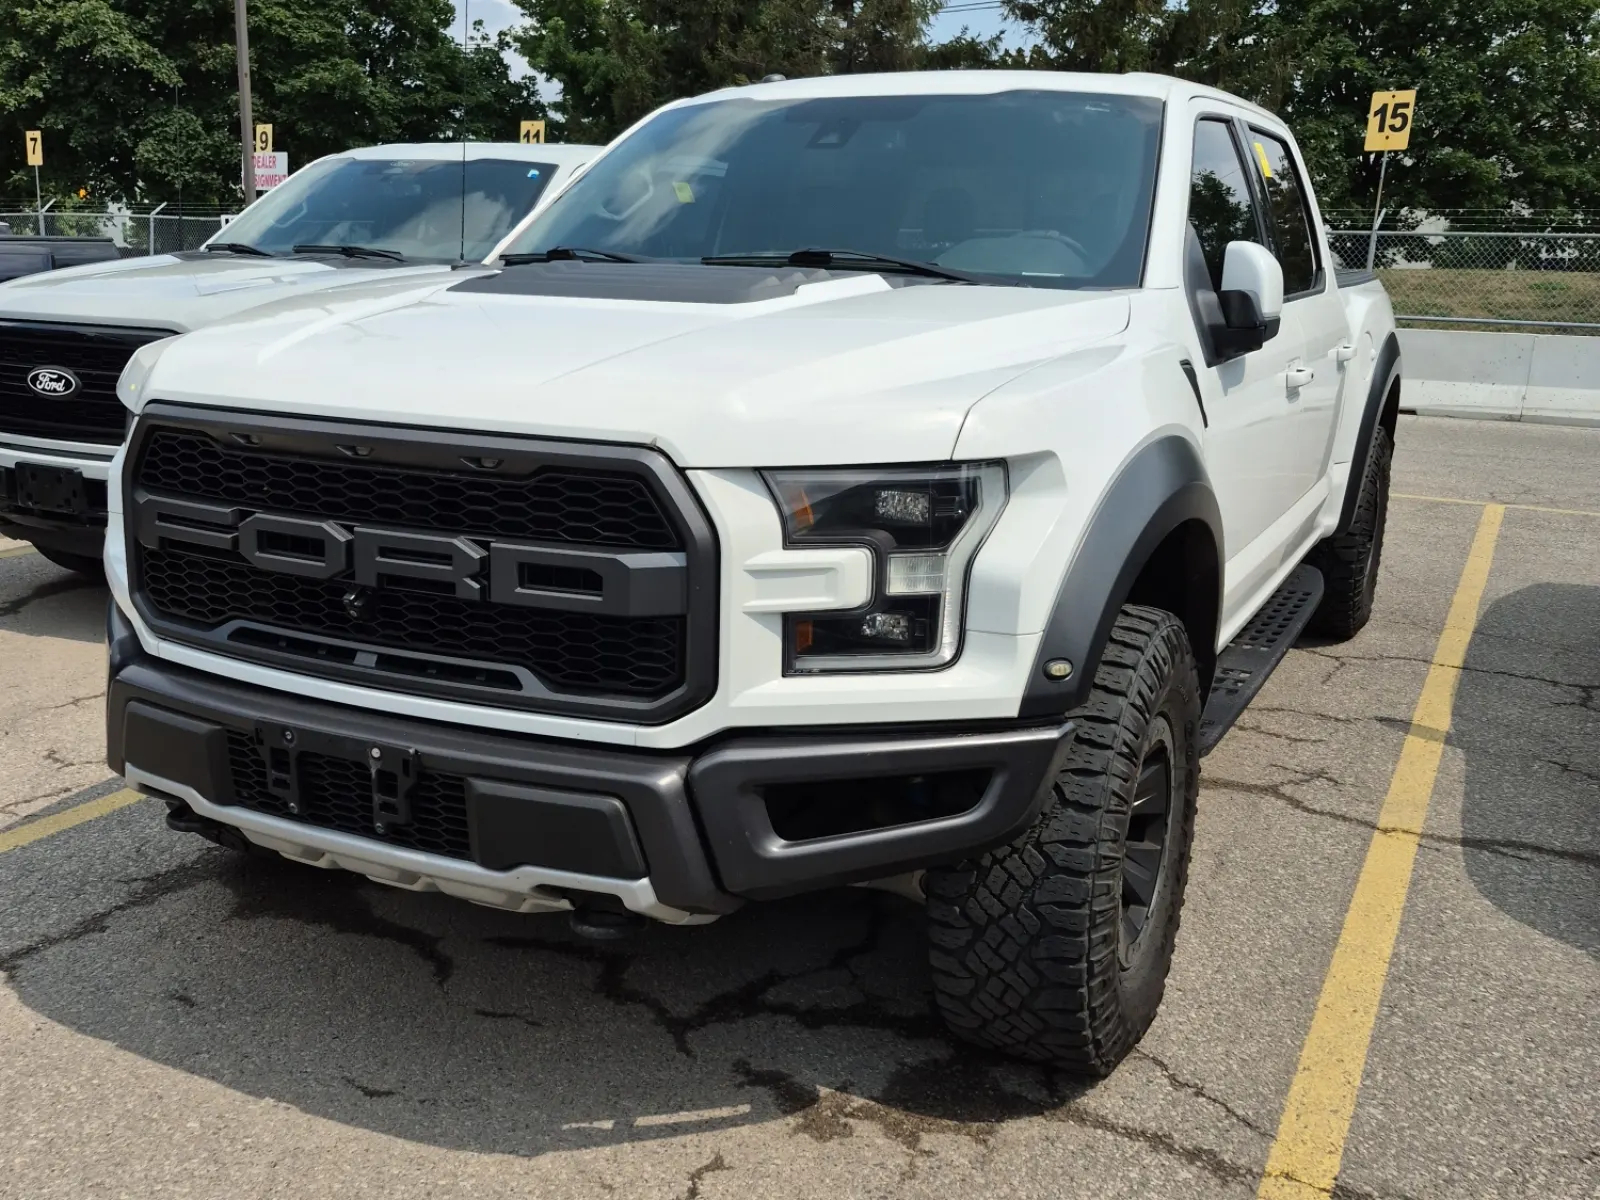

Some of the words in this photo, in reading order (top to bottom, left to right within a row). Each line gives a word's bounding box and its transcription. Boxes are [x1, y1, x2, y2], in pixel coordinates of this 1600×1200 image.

[1373, 102, 1410, 133] 15
[29, 137, 38, 155] 7
[259, 131, 269, 151] 9
[522, 129, 541, 144] 11
[36, 372, 66, 392] Ford
[137, 498, 645, 616] FORD
